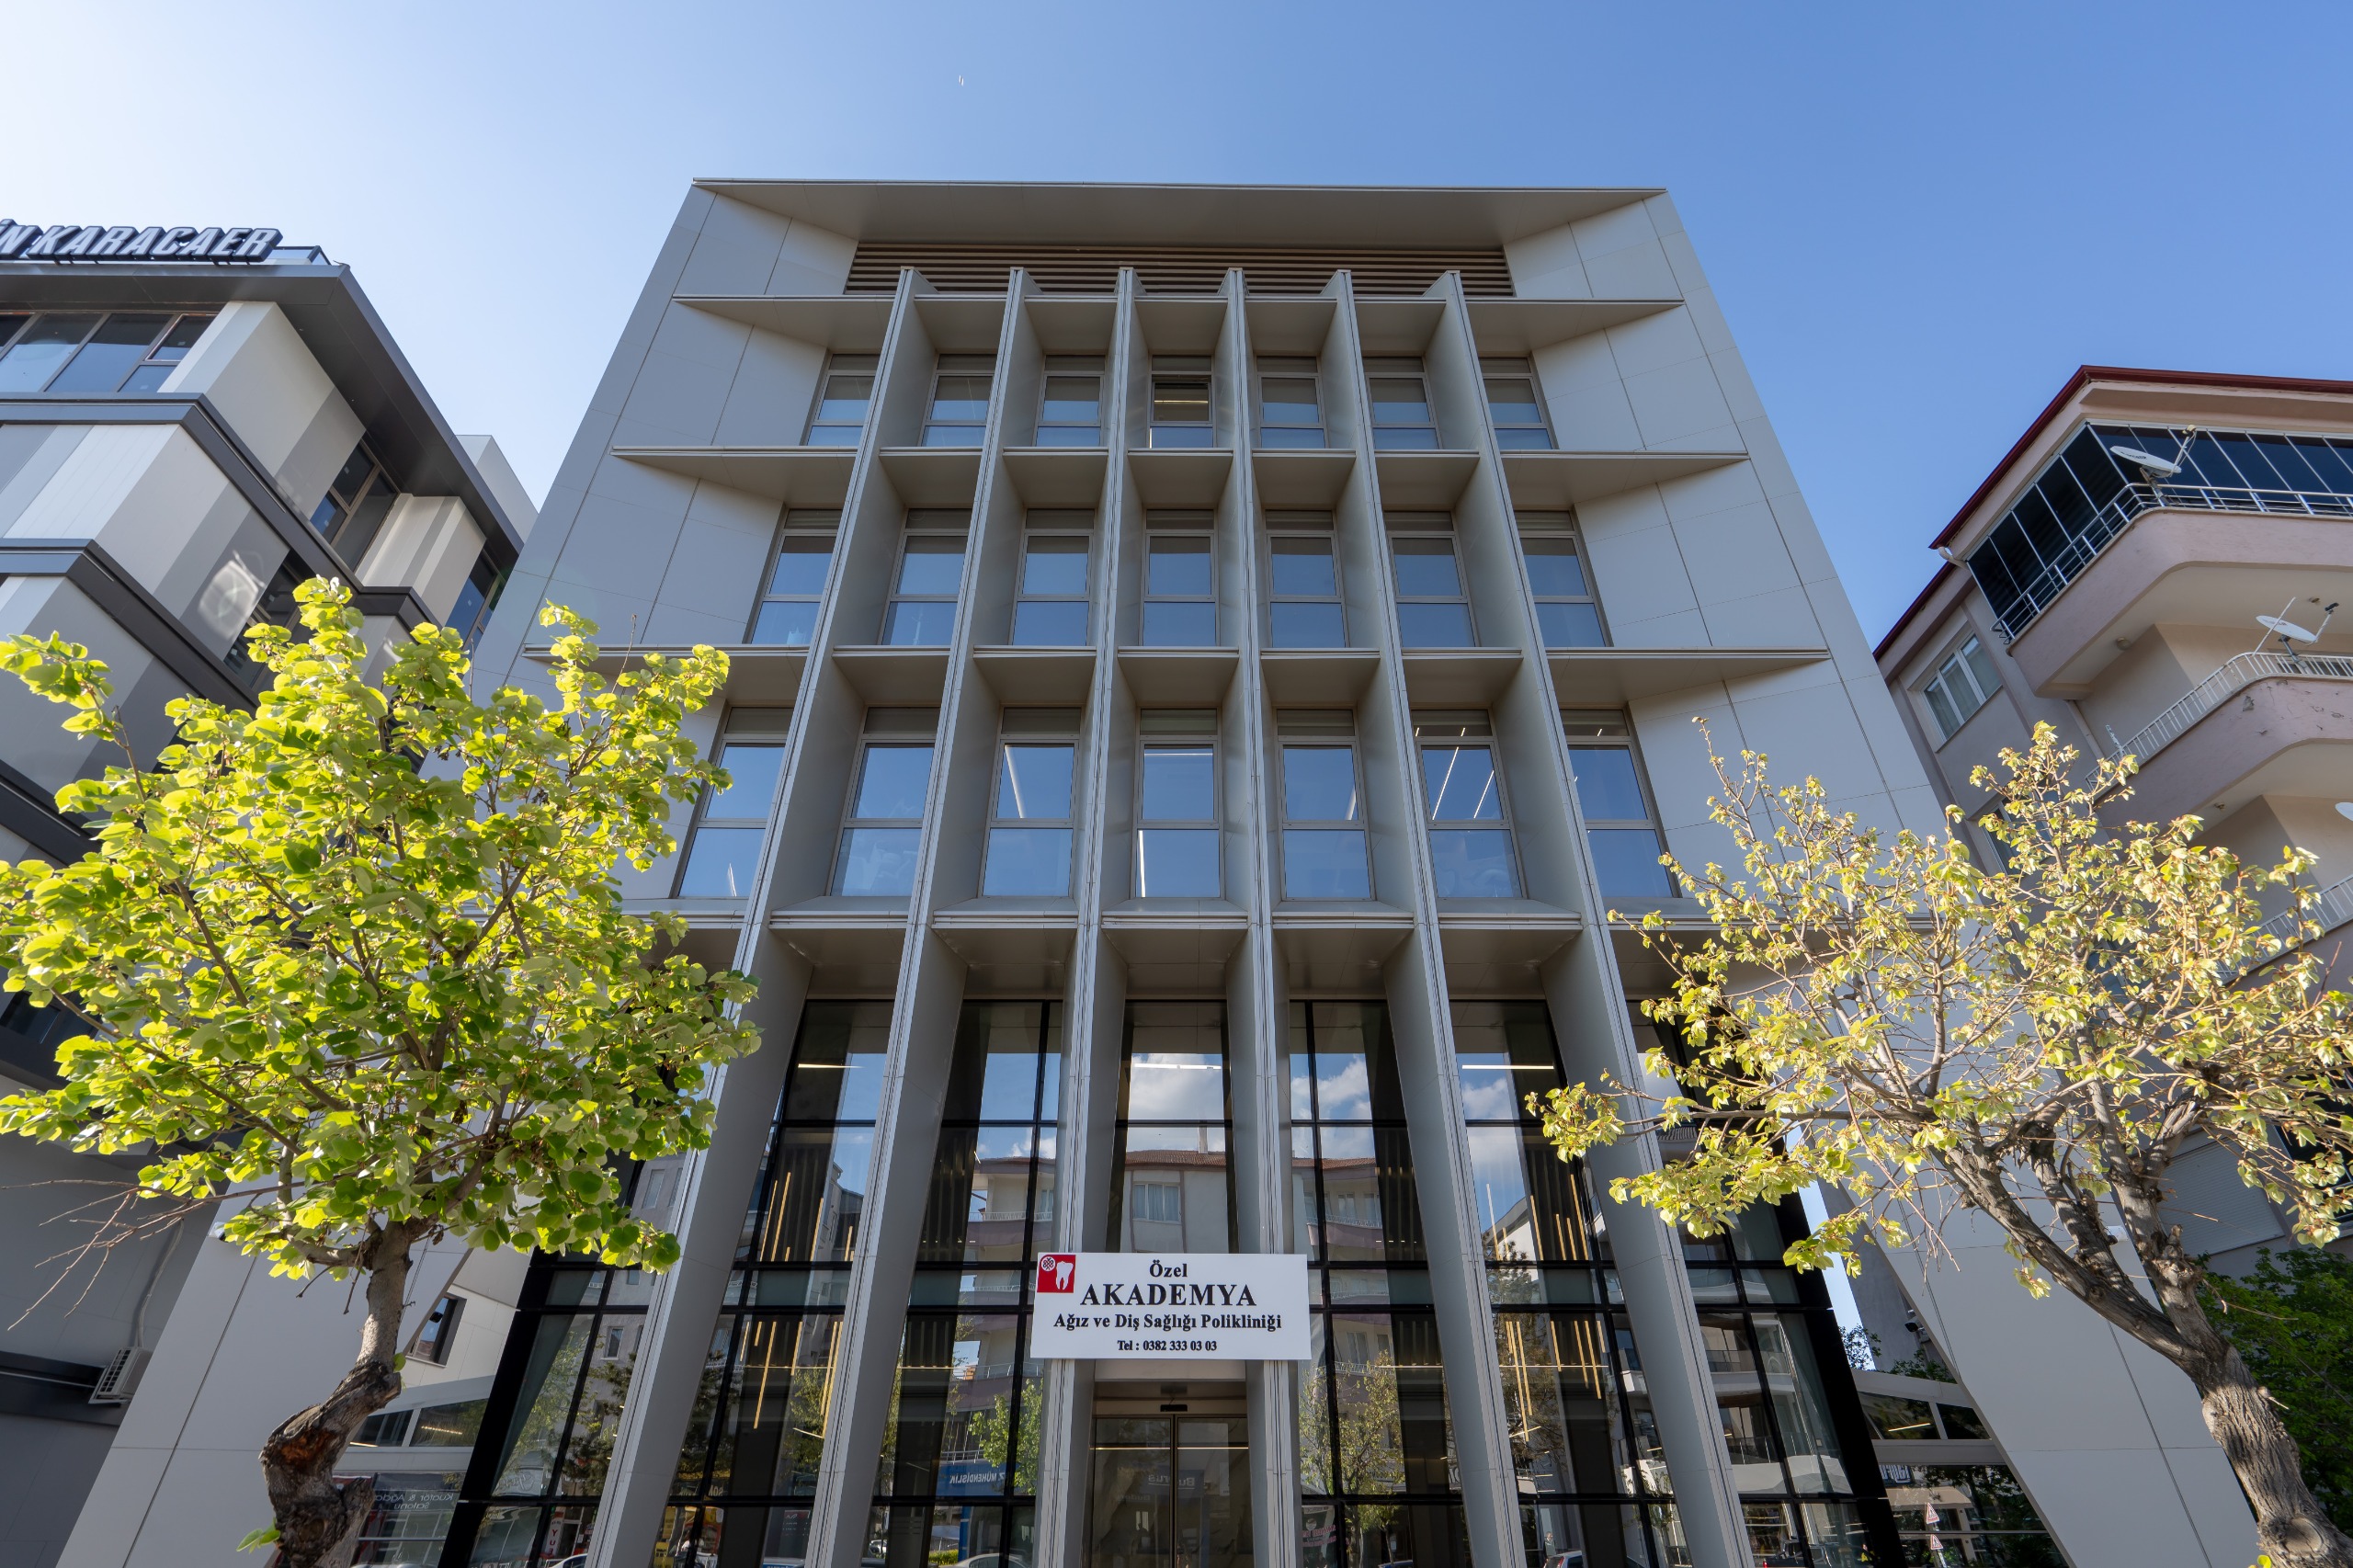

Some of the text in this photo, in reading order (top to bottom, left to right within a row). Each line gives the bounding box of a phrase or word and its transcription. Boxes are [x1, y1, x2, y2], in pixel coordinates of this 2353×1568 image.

[27, 226, 282, 262] KARACAER
[1149, 1259, 1188, 1278] Özel
[1080, 1283, 1256, 1307] AKADEMYA
[1053, 1313, 1282, 1332] Ağız ve Diş Sağlığı Polikliniği
[1117, 1340, 1133, 1351] Tel
[1142, 1340, 1167, 1351] 0382
[1169, 1340, 1188, 1351] 333
[1190, 1340, 1203, 1351] 03
[1205, 1340, 1218, 1351] 03
